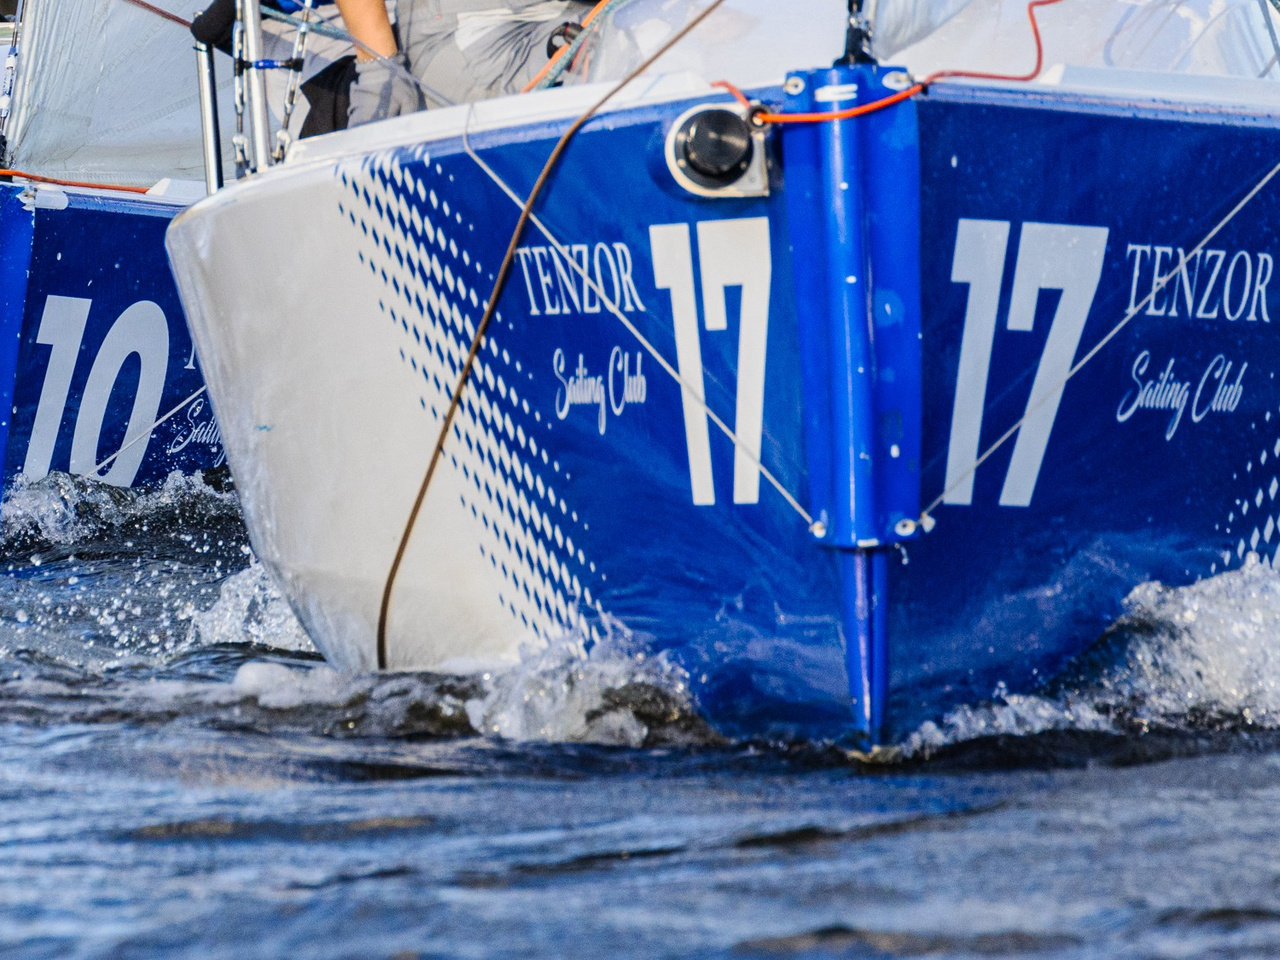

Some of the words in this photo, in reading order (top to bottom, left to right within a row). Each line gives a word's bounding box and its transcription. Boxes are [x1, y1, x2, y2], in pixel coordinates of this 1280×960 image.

[514, 242, 646, 316] TENZOR
[1125, 243, 1273, 323] TENZOR
[22, 295, 169, 488] 10
[552, 347, 606, 436] Sailing
[608, 345, 647, 416] Club
[649, 216, 772, 506] 17
[943, 218, 1109, 508] 17
[1117, 350, 1191, 441] Sailing
[1191, 354, 1246, 423] Club
